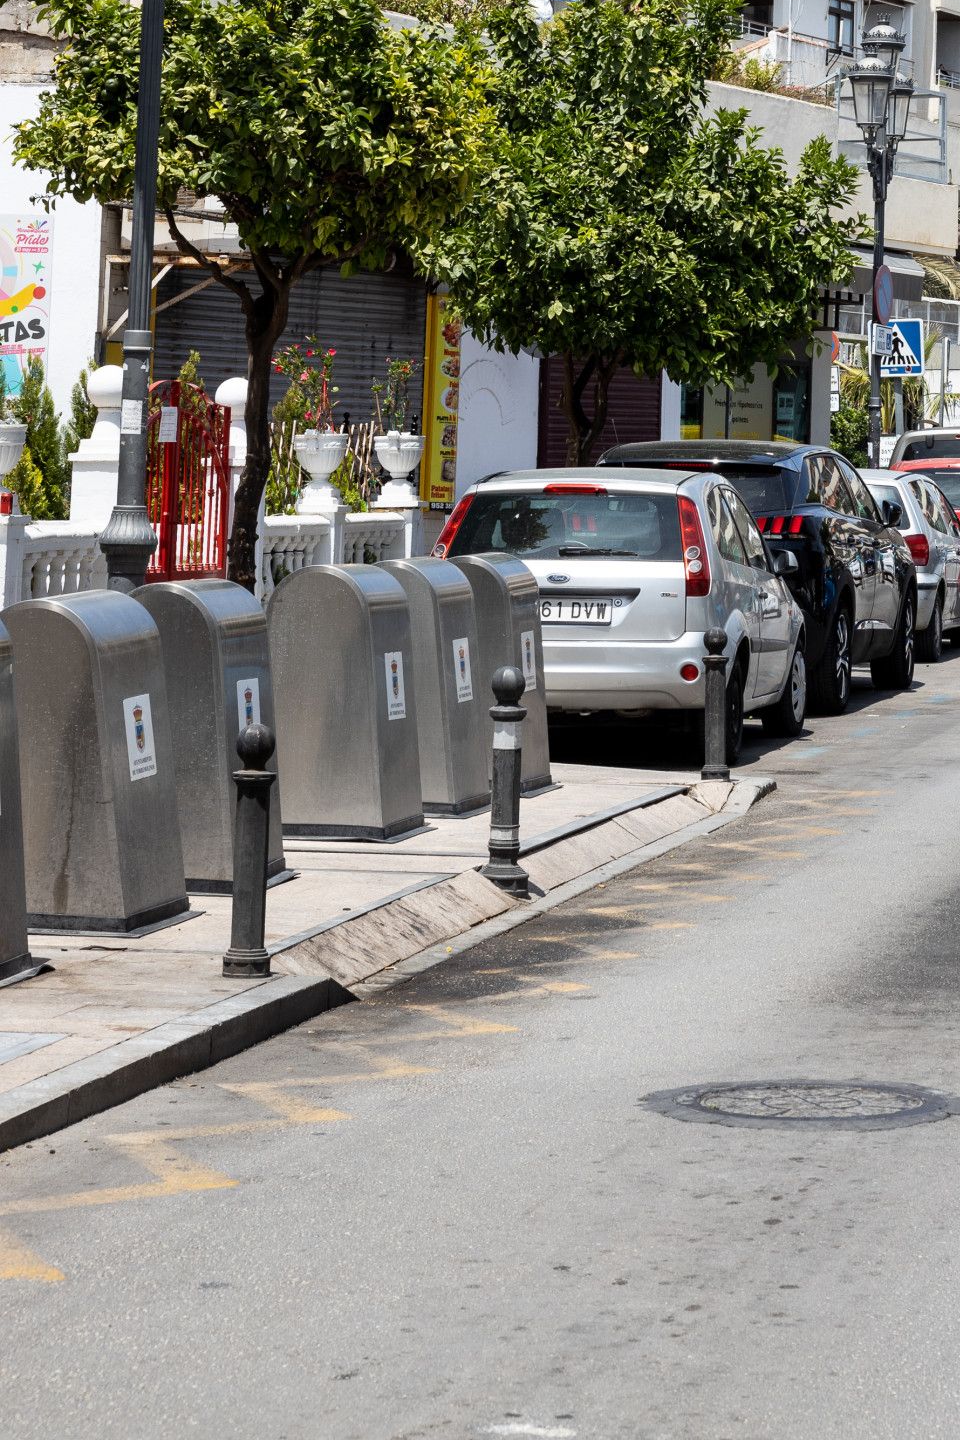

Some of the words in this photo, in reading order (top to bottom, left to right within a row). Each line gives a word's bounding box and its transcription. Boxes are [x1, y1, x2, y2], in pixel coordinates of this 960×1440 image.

[16, 233, 49, 245] Pride
[541, 601, 562, 618] 61
[571, 602, 607, 620] DVW
